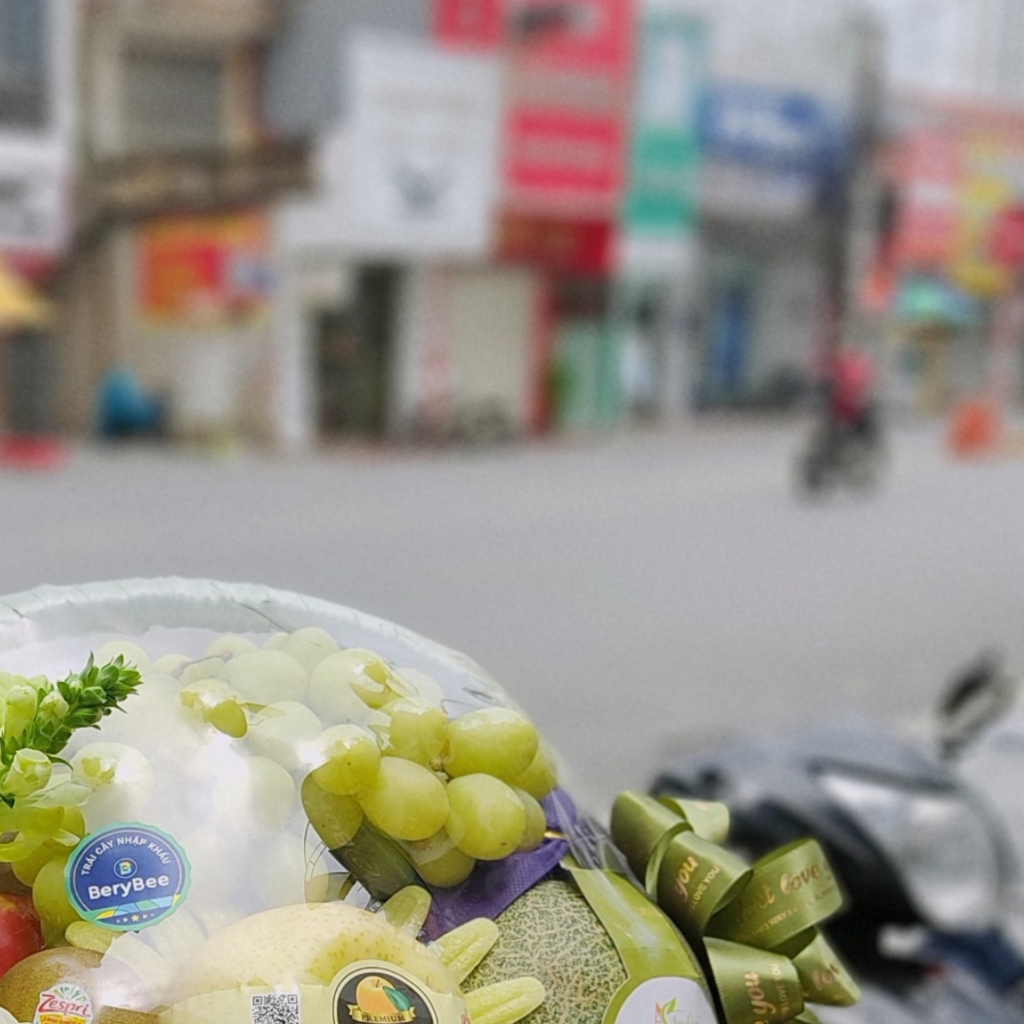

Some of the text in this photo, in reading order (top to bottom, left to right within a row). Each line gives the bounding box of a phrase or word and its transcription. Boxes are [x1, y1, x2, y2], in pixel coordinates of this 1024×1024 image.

[80, 854, 97, 876] TRÁI
[95, 840, 114, 855] CÂY
[117, 835, 147, 847] NHẬP
[88, 875, 169, 900] BeryBee
[38, 994, 91, 1017] Zespri
[361, 1014, 406, 1023] PREMIUM
